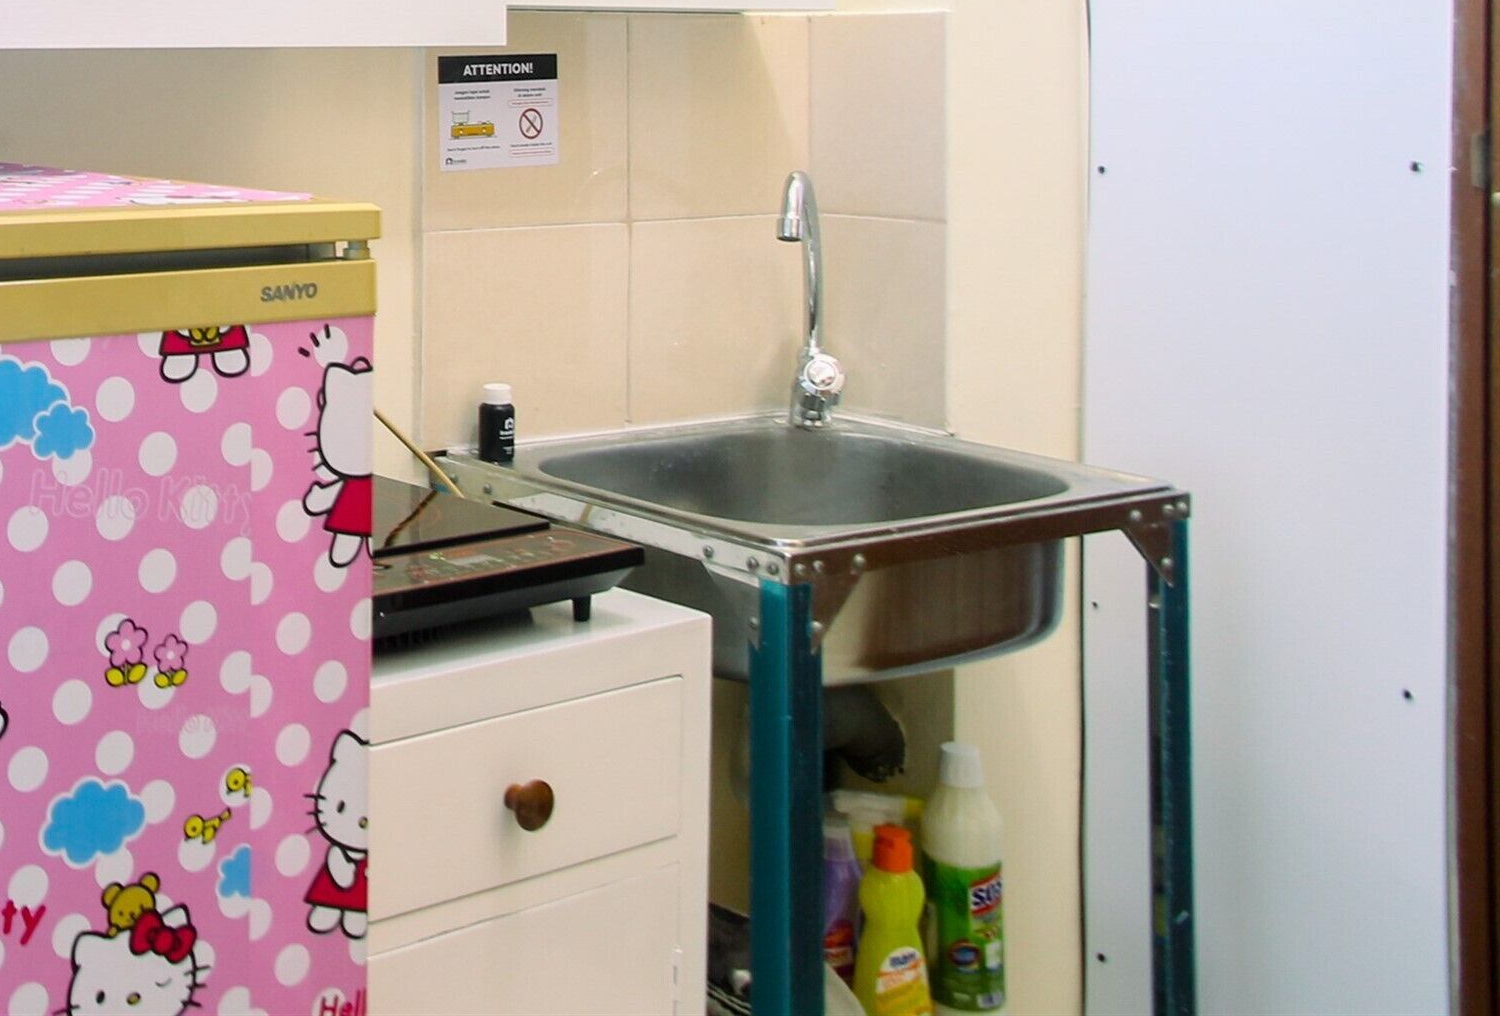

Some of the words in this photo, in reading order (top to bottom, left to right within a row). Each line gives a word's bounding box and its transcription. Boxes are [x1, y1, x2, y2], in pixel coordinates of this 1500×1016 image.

[463, 62, 533, 76] ATTENTION!
[260, 282, 317, 302] SANYO
[28, 468, 149, 521] Hello
